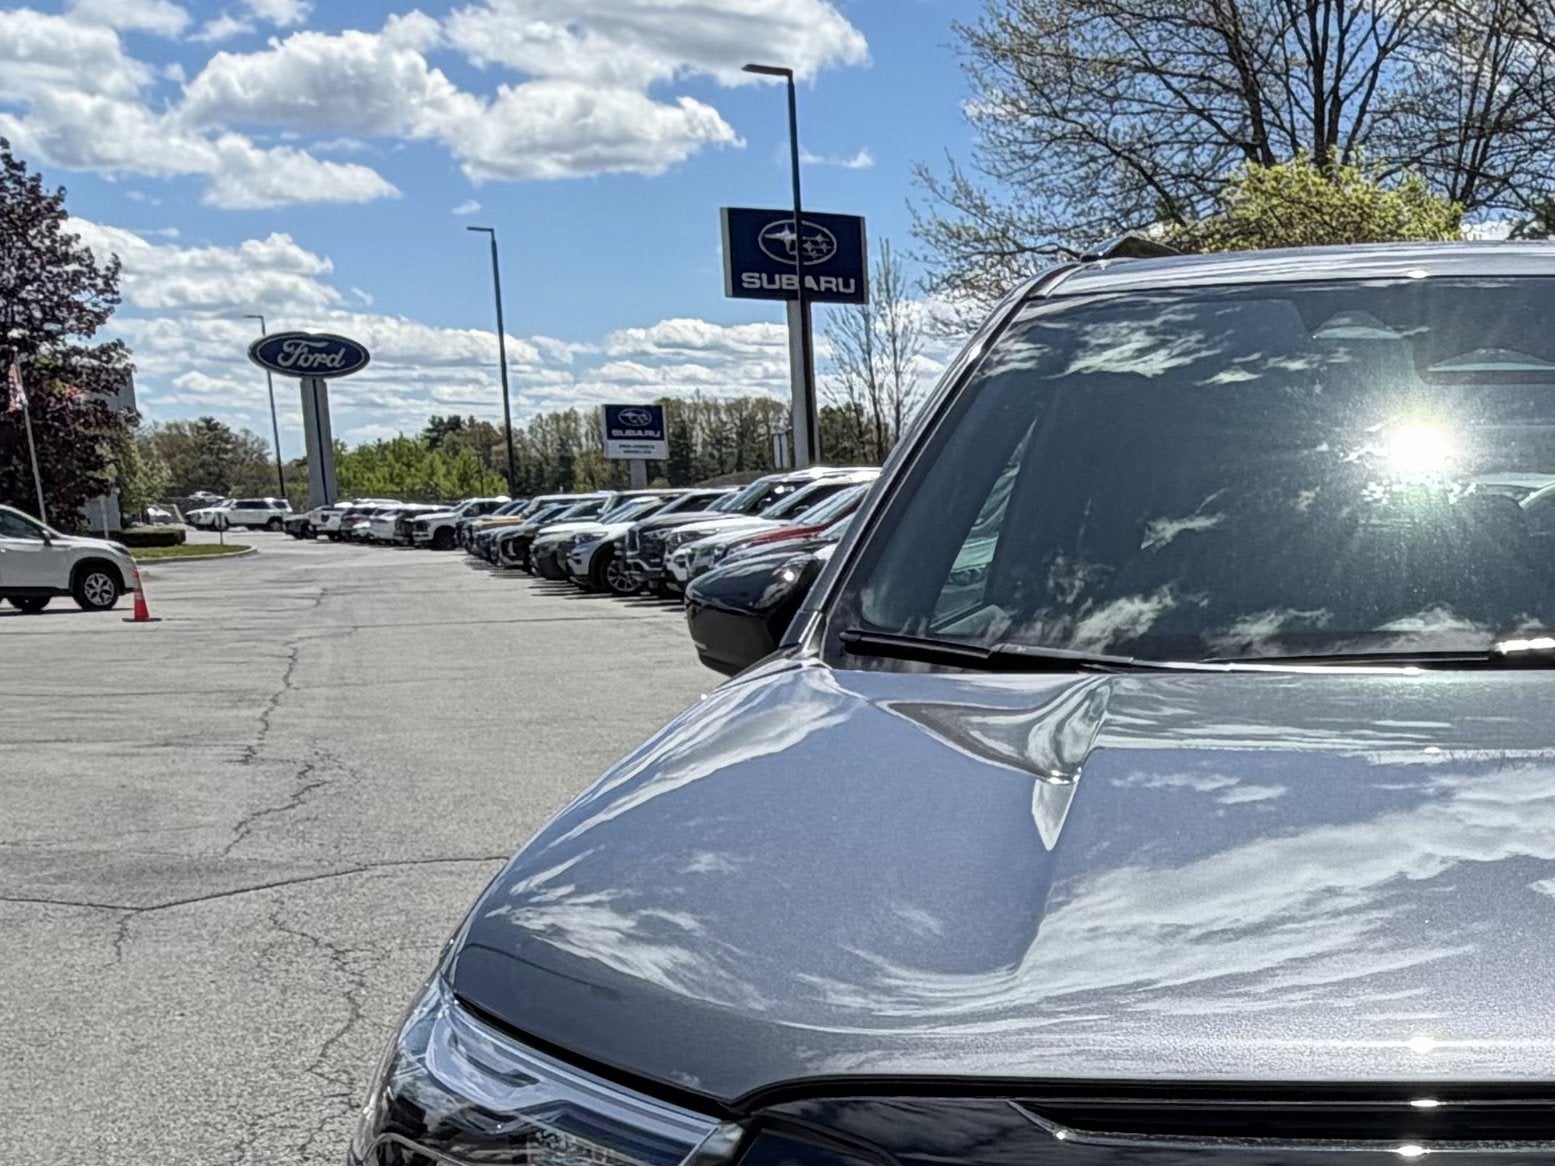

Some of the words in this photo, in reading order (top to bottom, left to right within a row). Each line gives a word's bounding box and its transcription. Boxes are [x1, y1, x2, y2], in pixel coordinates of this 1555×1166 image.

[741, 272, 856, 294] SUBARU
[277, 339, 346, 368] Ford
[611, 429, 661, 438] SUBARU
